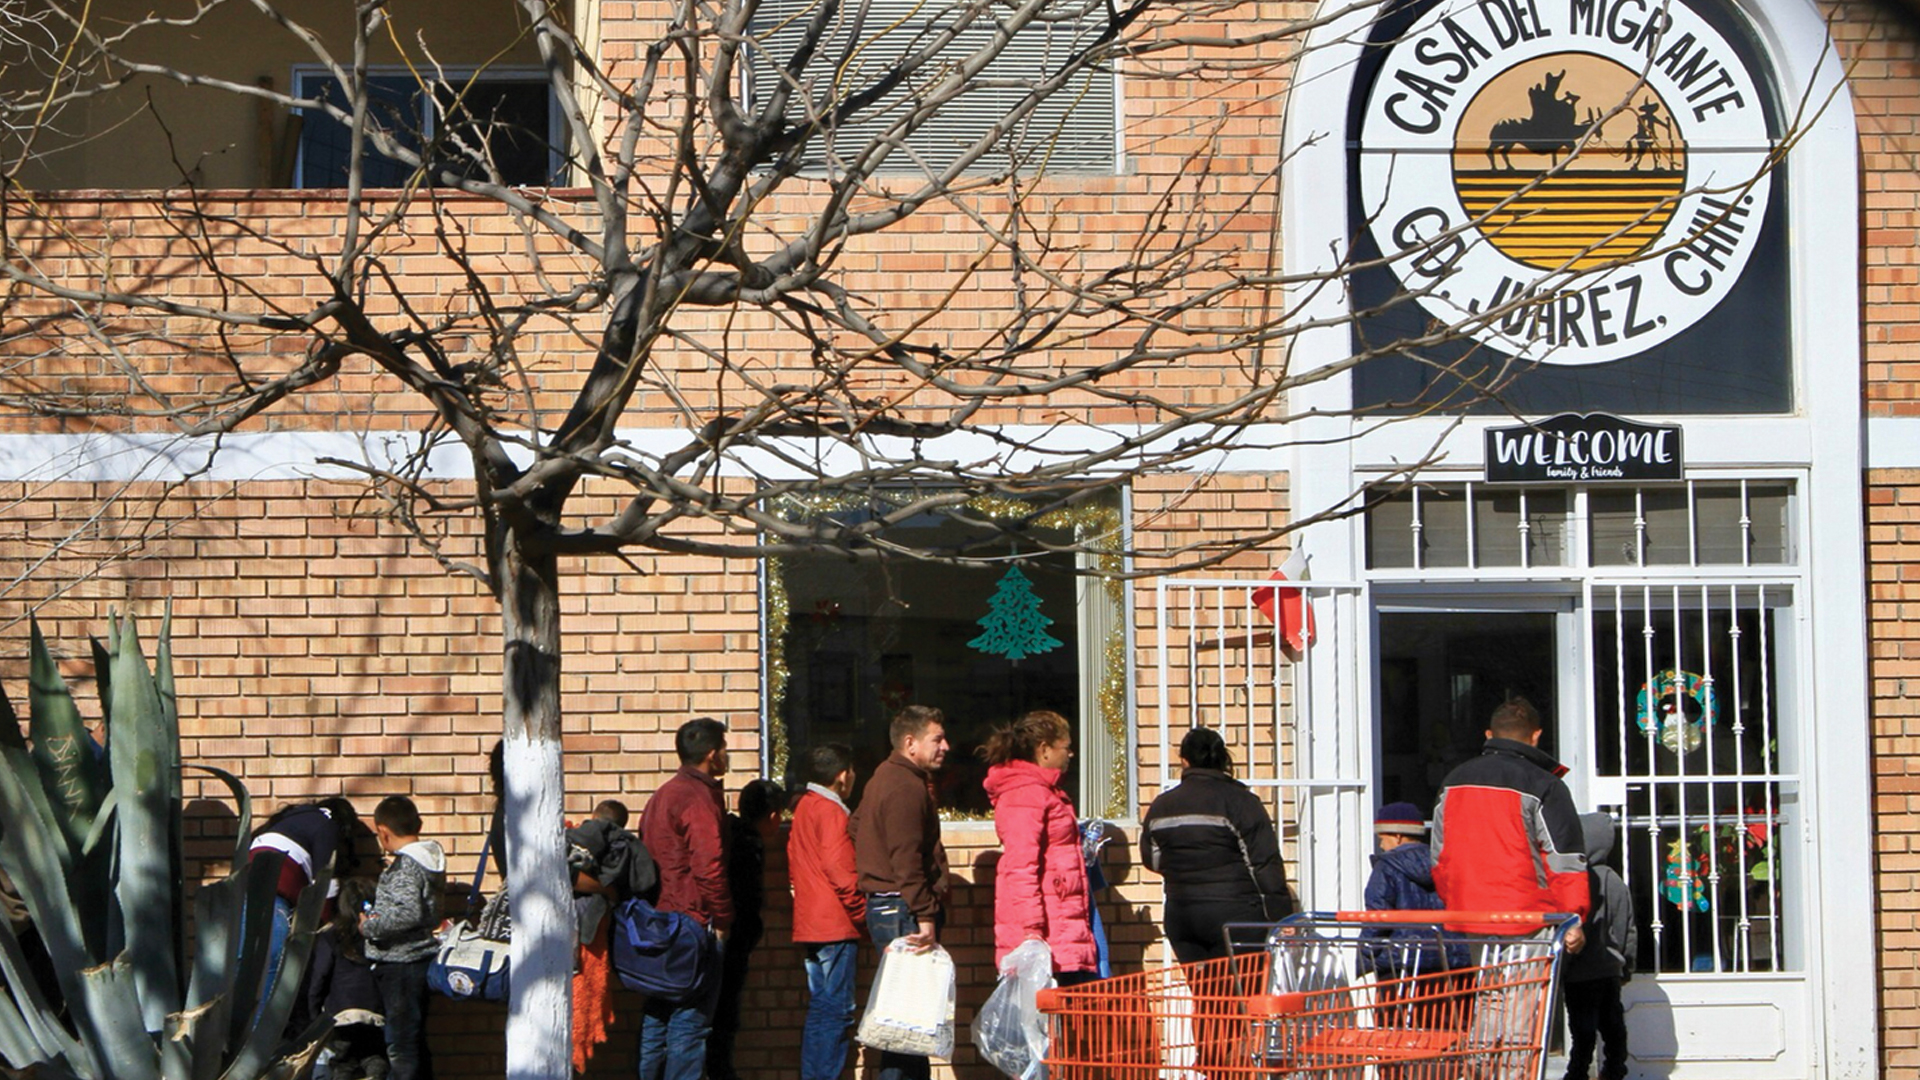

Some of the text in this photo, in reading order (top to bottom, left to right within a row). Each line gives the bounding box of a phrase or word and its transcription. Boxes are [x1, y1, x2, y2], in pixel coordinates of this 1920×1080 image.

[1384, 0, 1746, 135] CASA DEL MIGRANTE
[1664, 195, 1754, 297] CHIH.
[1494, 429, 1673, 465] WELCOME
[1580, 466, 1589, 479] &
